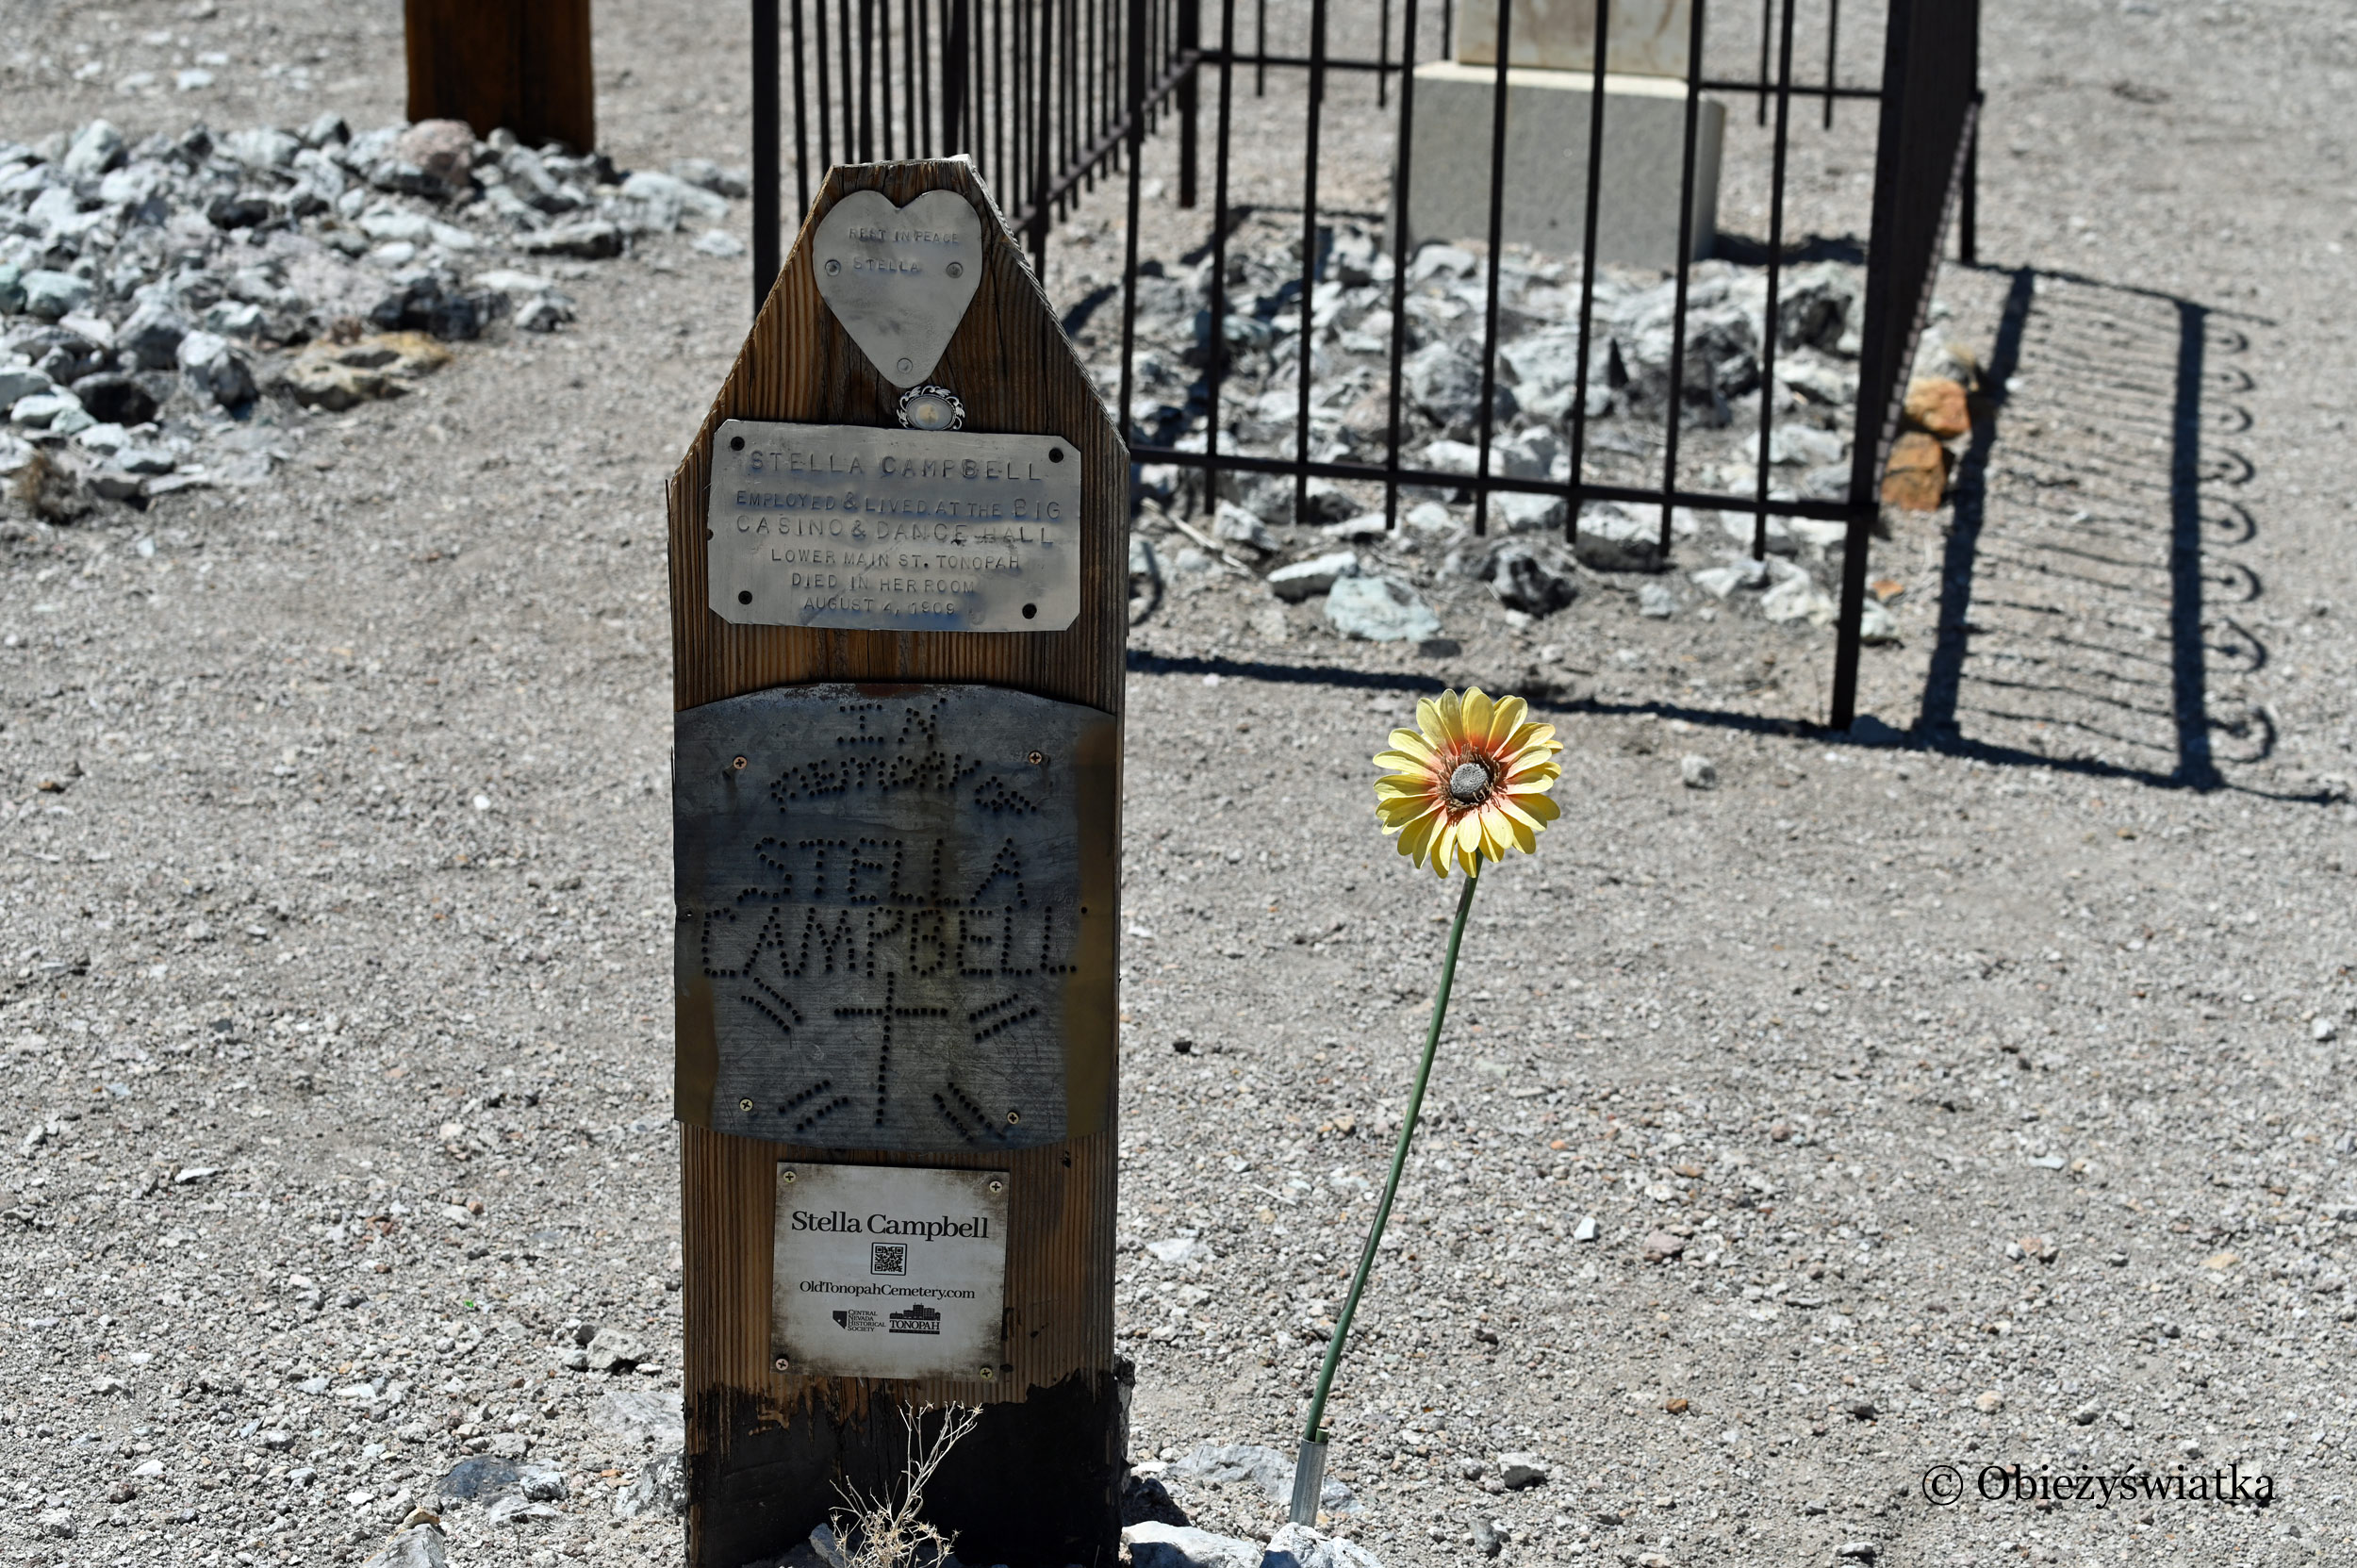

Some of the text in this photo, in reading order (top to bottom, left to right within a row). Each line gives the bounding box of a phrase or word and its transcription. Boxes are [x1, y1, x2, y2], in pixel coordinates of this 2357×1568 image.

[849, 228, 959, 245] REST IN PEACE
[853, 256, 921, 272] STELLA
[750, 451, 1042, 481] STELLA CAMPBELL
[736, 490, 835, 511] EMPLOYED
[842, 491, 858, 511] &
[935, 501, 960, 516] AT
[967, 503, 1003, 518] THE
[1014, 498, 1061, 520] BIG
[736, 515, 1054, 544] CASINO & DANCE HALL
[771, 548, 1020, 569] LOWER MAIN ST. TONOPAH
[792, 572, 975, 594] DIED IN HER ROOM
[803, 597, 875, 613] AUGUST
[836, 698, 948, 744] IN
[736, 836, 1029, 906] STELLA
[701, 904, 1078, 978] CAMPBELL
[791, 1211, 989, 1242] Stella Campbell
[799, 1280, 976, 1300] OldTonopahCemetery.com
[889, 1320, 941, 1330] TONOPAH
